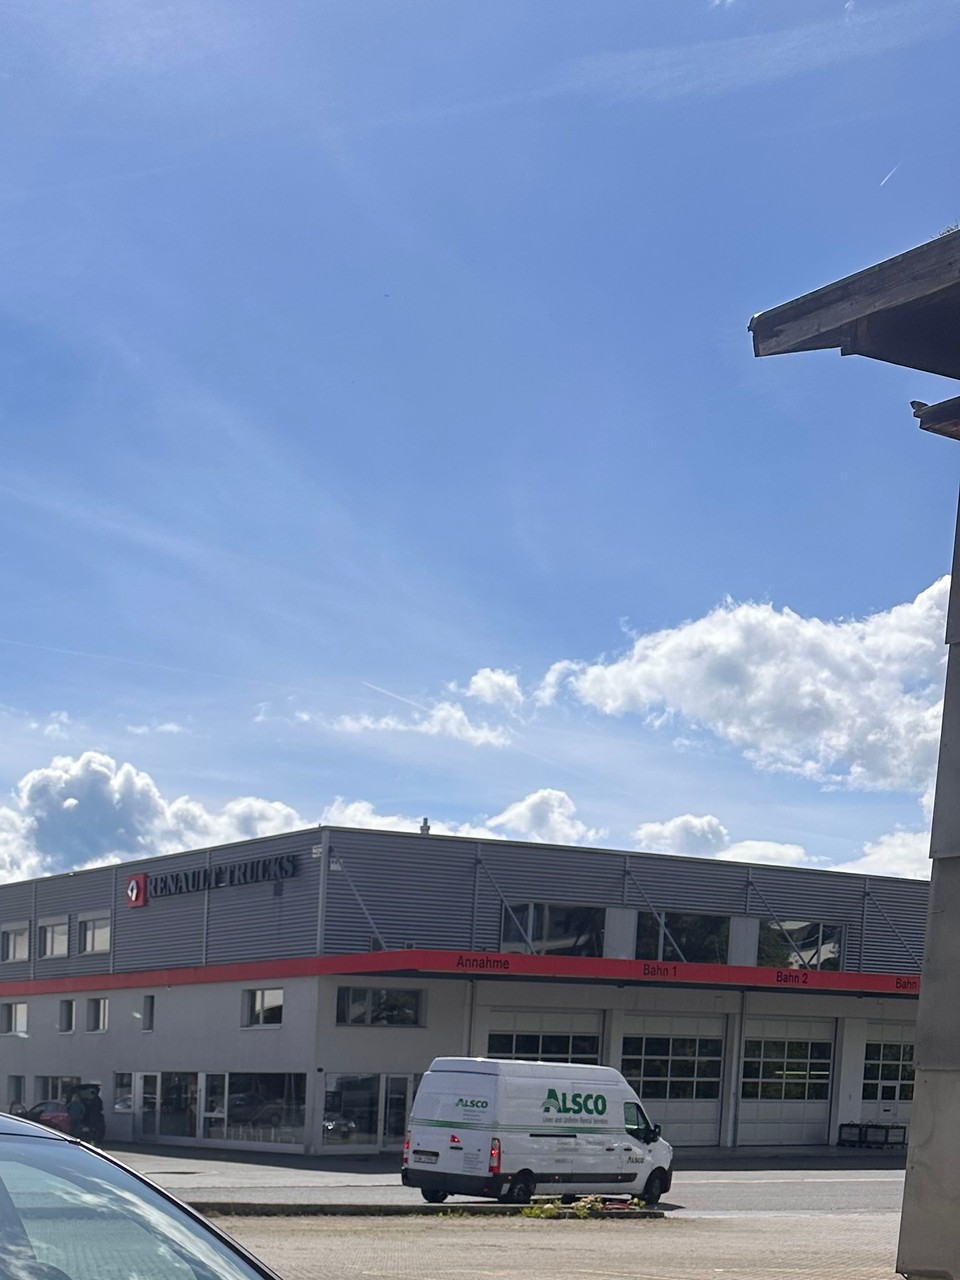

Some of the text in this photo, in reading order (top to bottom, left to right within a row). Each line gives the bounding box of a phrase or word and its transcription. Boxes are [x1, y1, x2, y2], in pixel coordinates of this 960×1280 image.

[148, 854, 296, 898] RENAULT TRUCKS
[456, 954, 510, 969] Annahme
[643, 964, 678, 977] Bahn 1
[776, 971, 809, 984] Bahn 2
[895, 978, 918, 989] Bahn
[455, 1098, 488, 1109] ALSCO
[541, 1088, 607, 1116] ALSCO
[627, 1156, 645, 1164] ALSCO
